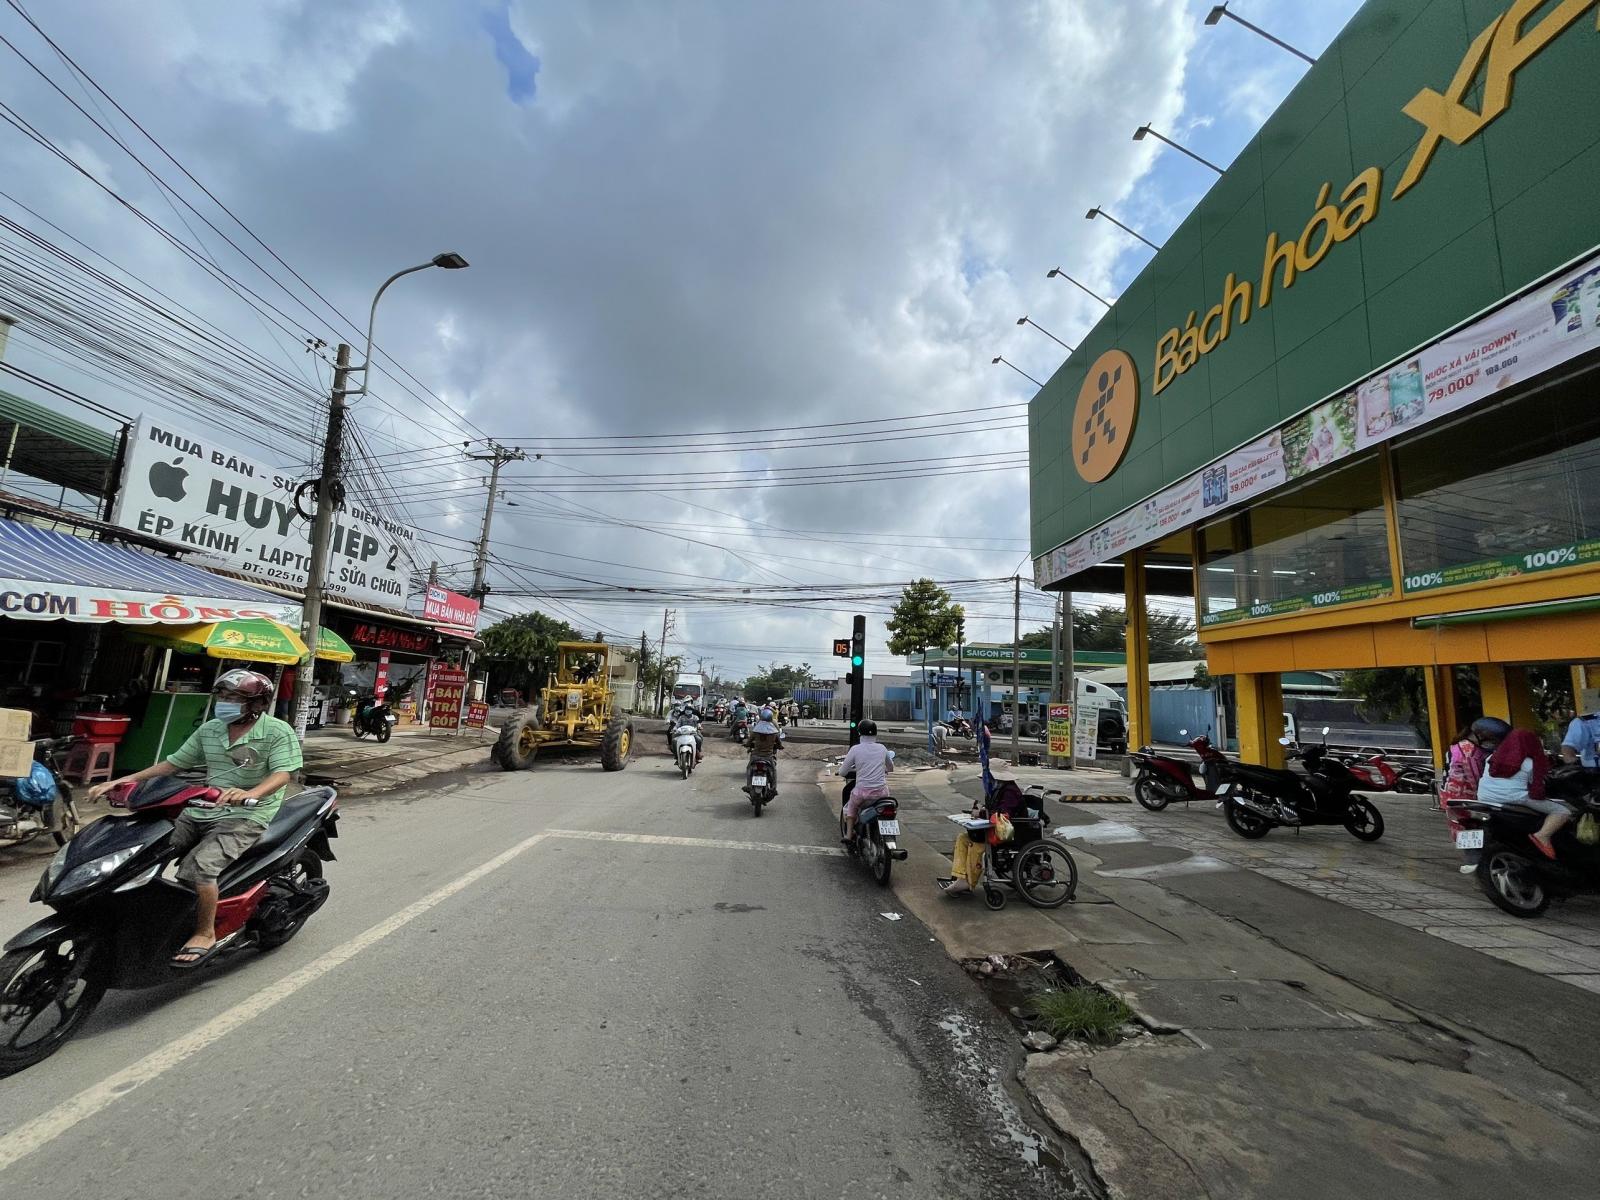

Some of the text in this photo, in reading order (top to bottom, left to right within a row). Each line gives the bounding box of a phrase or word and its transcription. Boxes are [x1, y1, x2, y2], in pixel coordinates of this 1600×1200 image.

[1153, 0, 1600, 396] Bách hóa XA
[1481, 330, 1518, 355] DOWNY
[149, 426, 203, 459] MUA
[211, 455, 254, 477] BÁN
[272, 475, 308, 498] SỬ
[206, 478, 399, 571] HUY IỆP 2
[137, 508, 401, 597] ÉP KÍNH LAPTO SỬA CHỮA
[1523, 546, 1577, 569] 100%
[242, 562, 264, 573] ĐT:
[267, 568, 304, 583] 02516
[1404, 571, 1443, 590] 100%
[0, 591, 78, 616] CƠM
[1313, 591, 1341, 605] 100%
[426, 601, 477, 626] MUA BÁN NHÀ ĐẤT
[1203, 615, 1219, 624] 100%
[1251, 604, 1272, 616] 100%
[836, 643, 847, 654] 05
[966, 649, 1027, 658] SAIGON PETO
[435, 687, 461, 699] BÁN
[434, 699, 458, 713] TRẢ
[431, 714, 458, 727] GÓP
